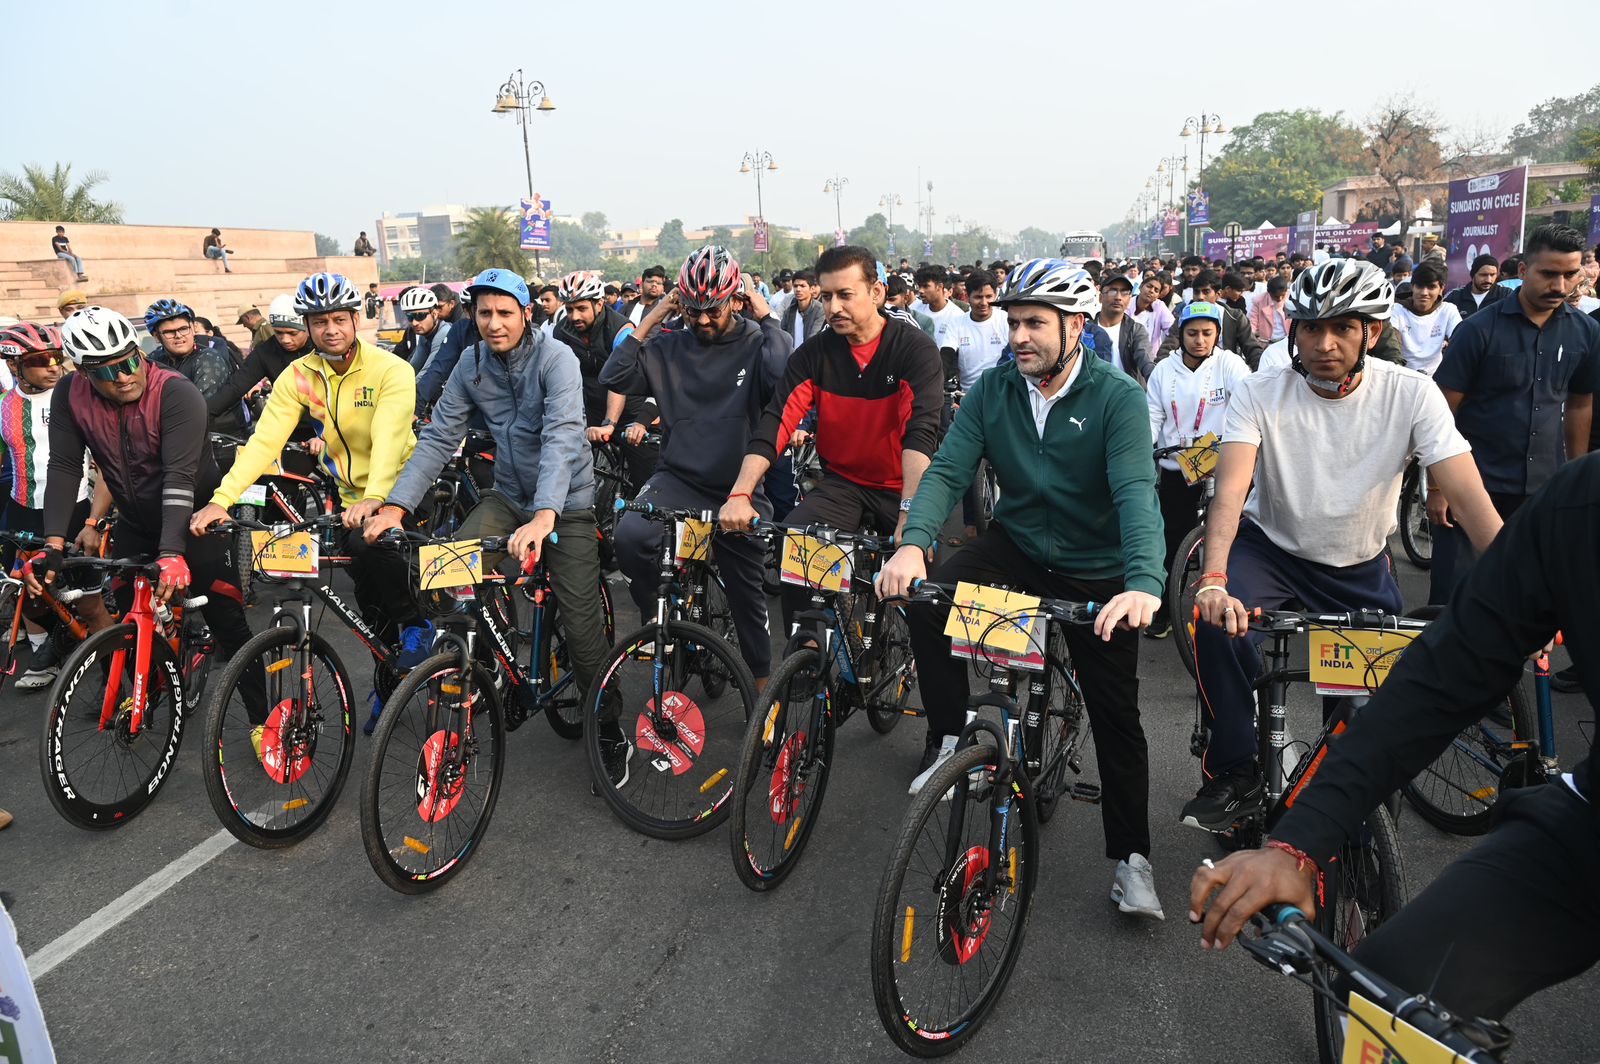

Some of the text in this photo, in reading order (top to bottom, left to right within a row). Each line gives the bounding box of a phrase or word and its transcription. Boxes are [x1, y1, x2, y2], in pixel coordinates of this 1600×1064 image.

[1450, 193, 1520, 214] SUNDAYS ON CYCLE
[1258, 233, 1283, 241] CYCLE
[1462, 224, 1499, 237] JOURNALIST
[320, 585, 375, 639] RALEIGH
[956, 614, 980, 626] INDIA
[482, 606, 515, 662] RALEIGH
[1320, 659, 1354, 670] INDIA
[133, 673, 144, 715] TREK
[55, 651, 97, 800] BONTRAGER
[148, 660, 182, 794] BONTRAGER
[640, 727, 682, 767] RALEIGH
